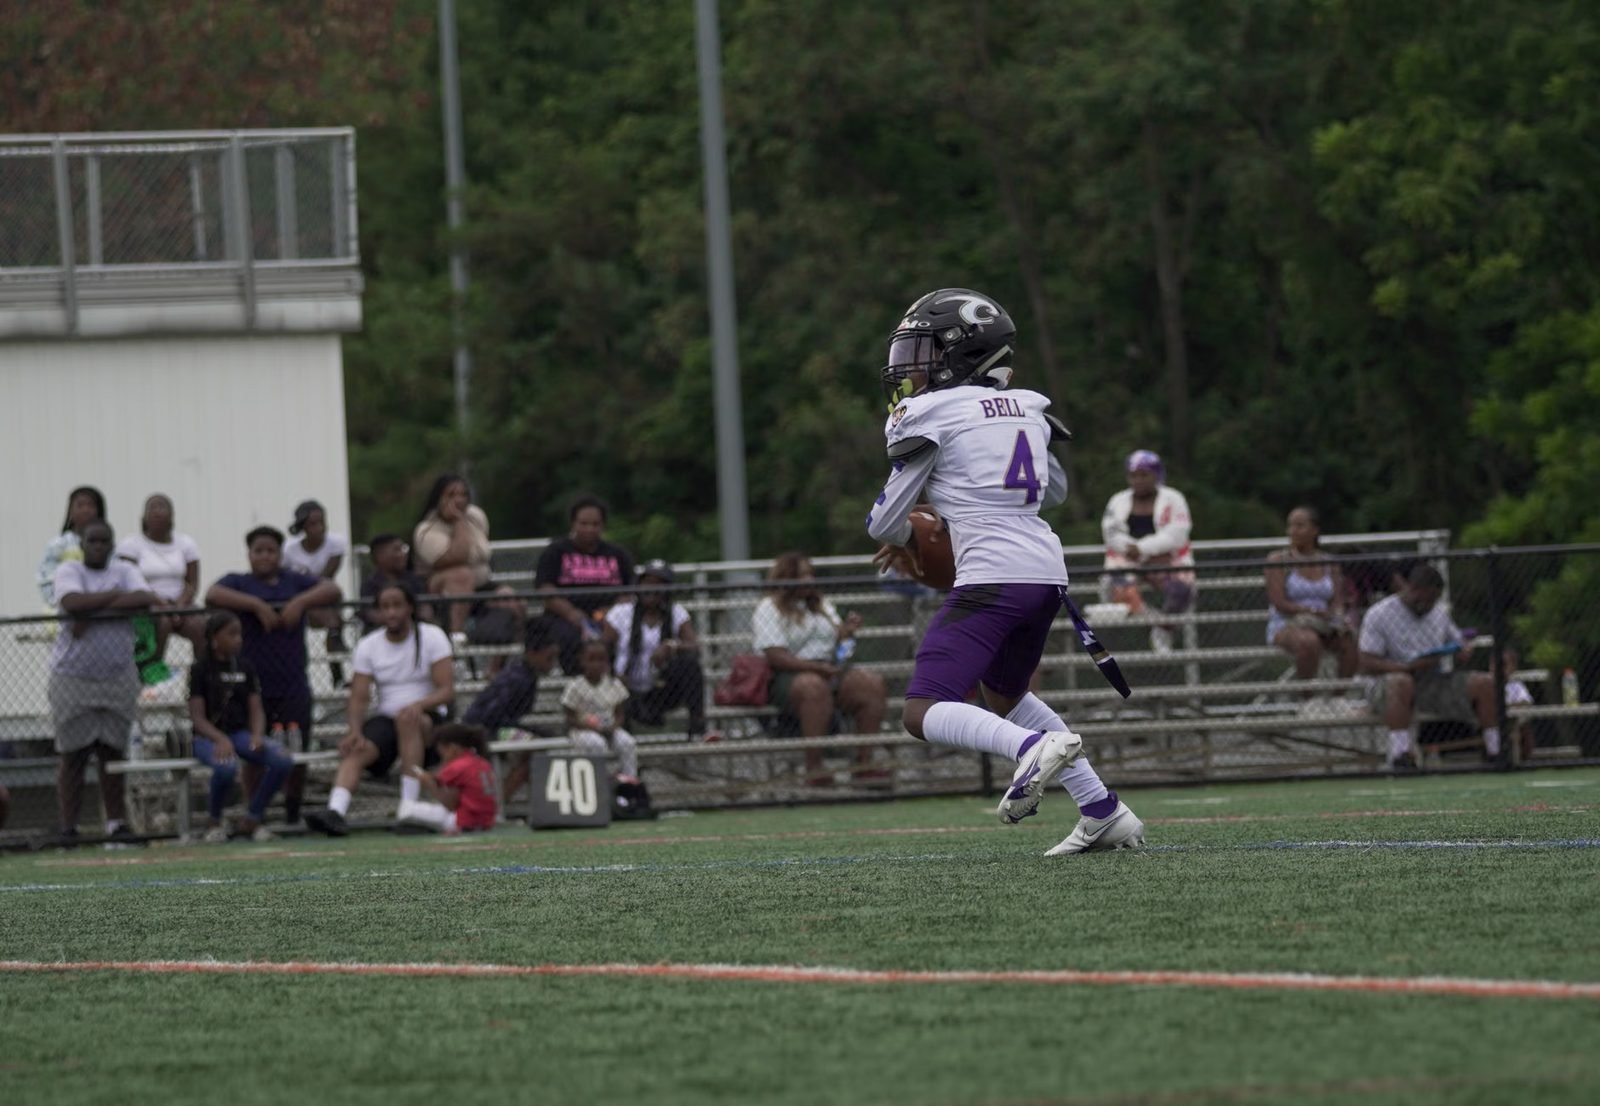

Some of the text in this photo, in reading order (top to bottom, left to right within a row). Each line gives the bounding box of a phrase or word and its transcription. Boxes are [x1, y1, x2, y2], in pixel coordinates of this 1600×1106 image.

[979, 397, 1026, 418] BELL
[1003, 429, 1042, 505] 4
[545, 757, 598, 816] 40
